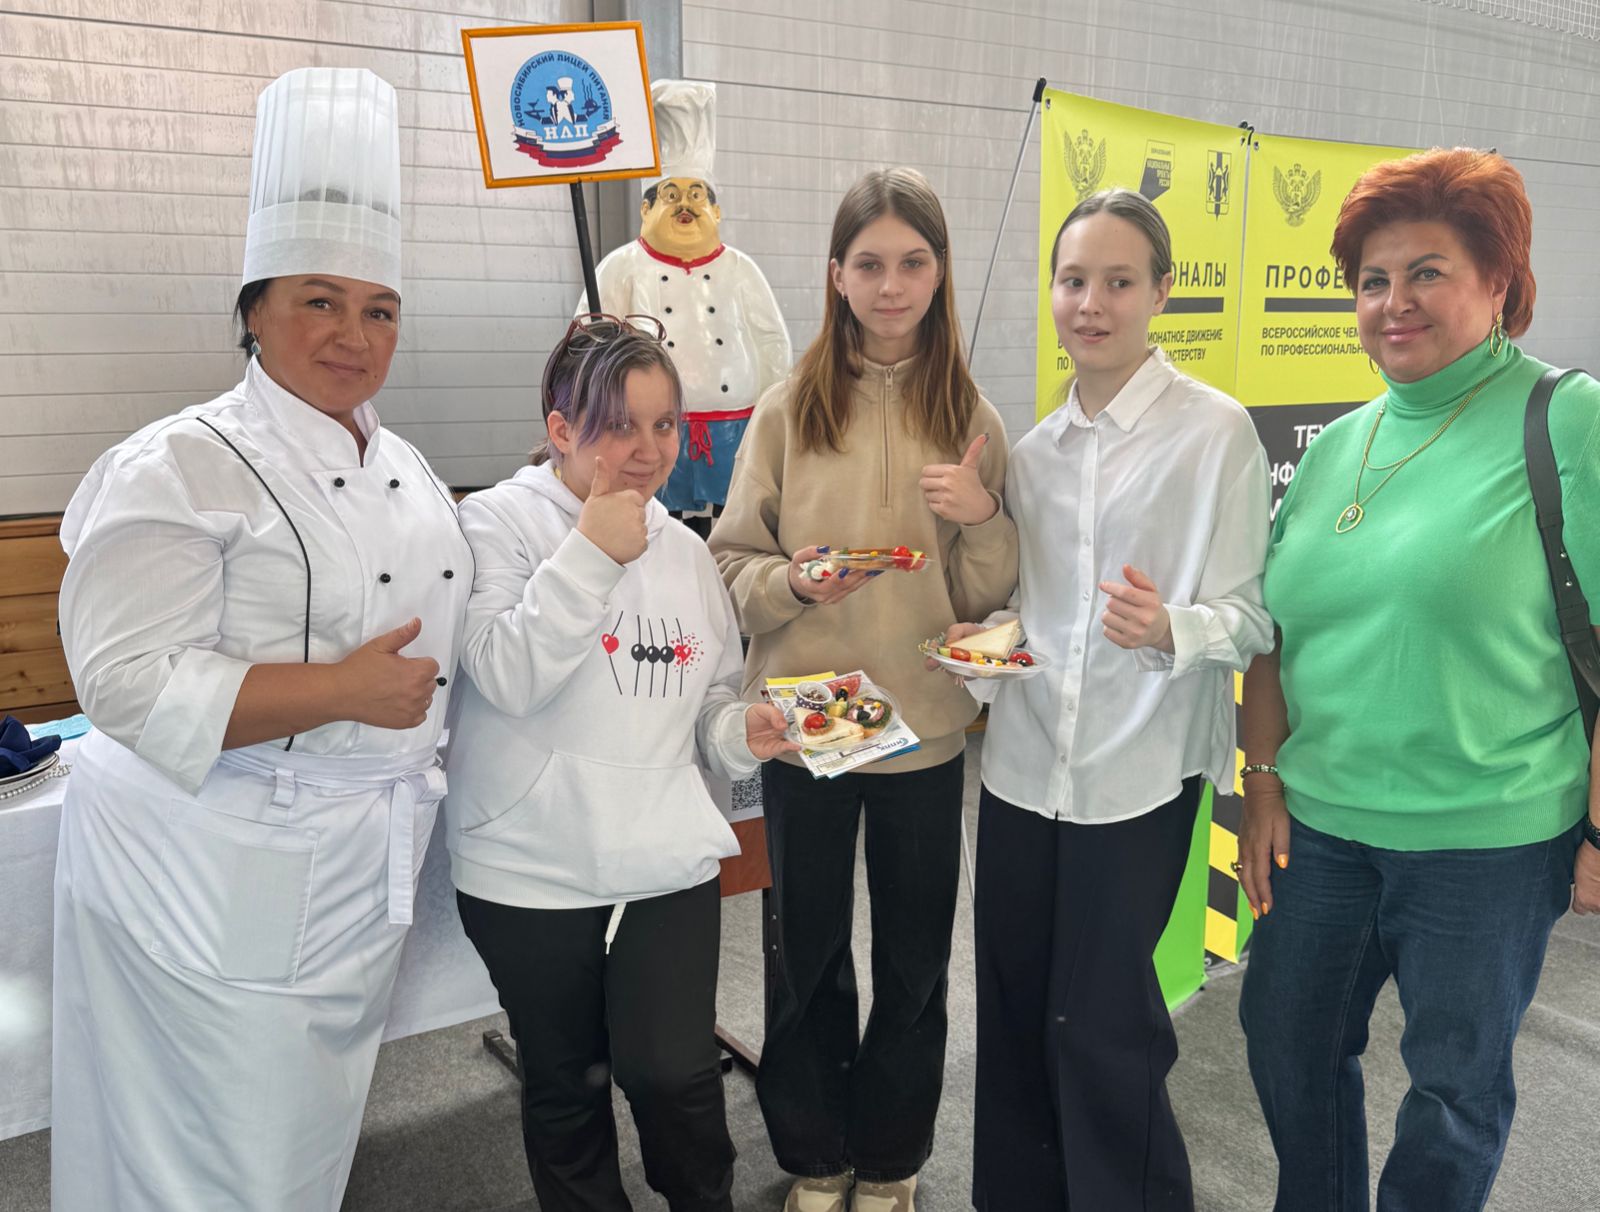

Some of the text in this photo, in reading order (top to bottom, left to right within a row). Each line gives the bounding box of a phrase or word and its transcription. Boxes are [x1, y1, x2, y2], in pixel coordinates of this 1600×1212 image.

[514, 53, 554, 127] НОВОСИБИРСКИЙ
[588, 71, 610, 120] ПИТАНИЯ
[543, 124, 589, 140] НЛП
[1265, 265, 1344, 290] ПРОФЕ
[1147, 328, 1223, 345] ИОНАТНОЕ ДВИЖЕНИЕ
[1261, 324, 1341, 339] ВСЕРОССИЙСКОЕ
[1166, 347, 1207, 362] АСТЕРСТВУ
[1260, 343, 1365, 356] ПО ПРОФЕССИОНАЛЬН
[1057, 356, 1069, 371] ПО
[1293, 424, 1323, 449] ТЕ
